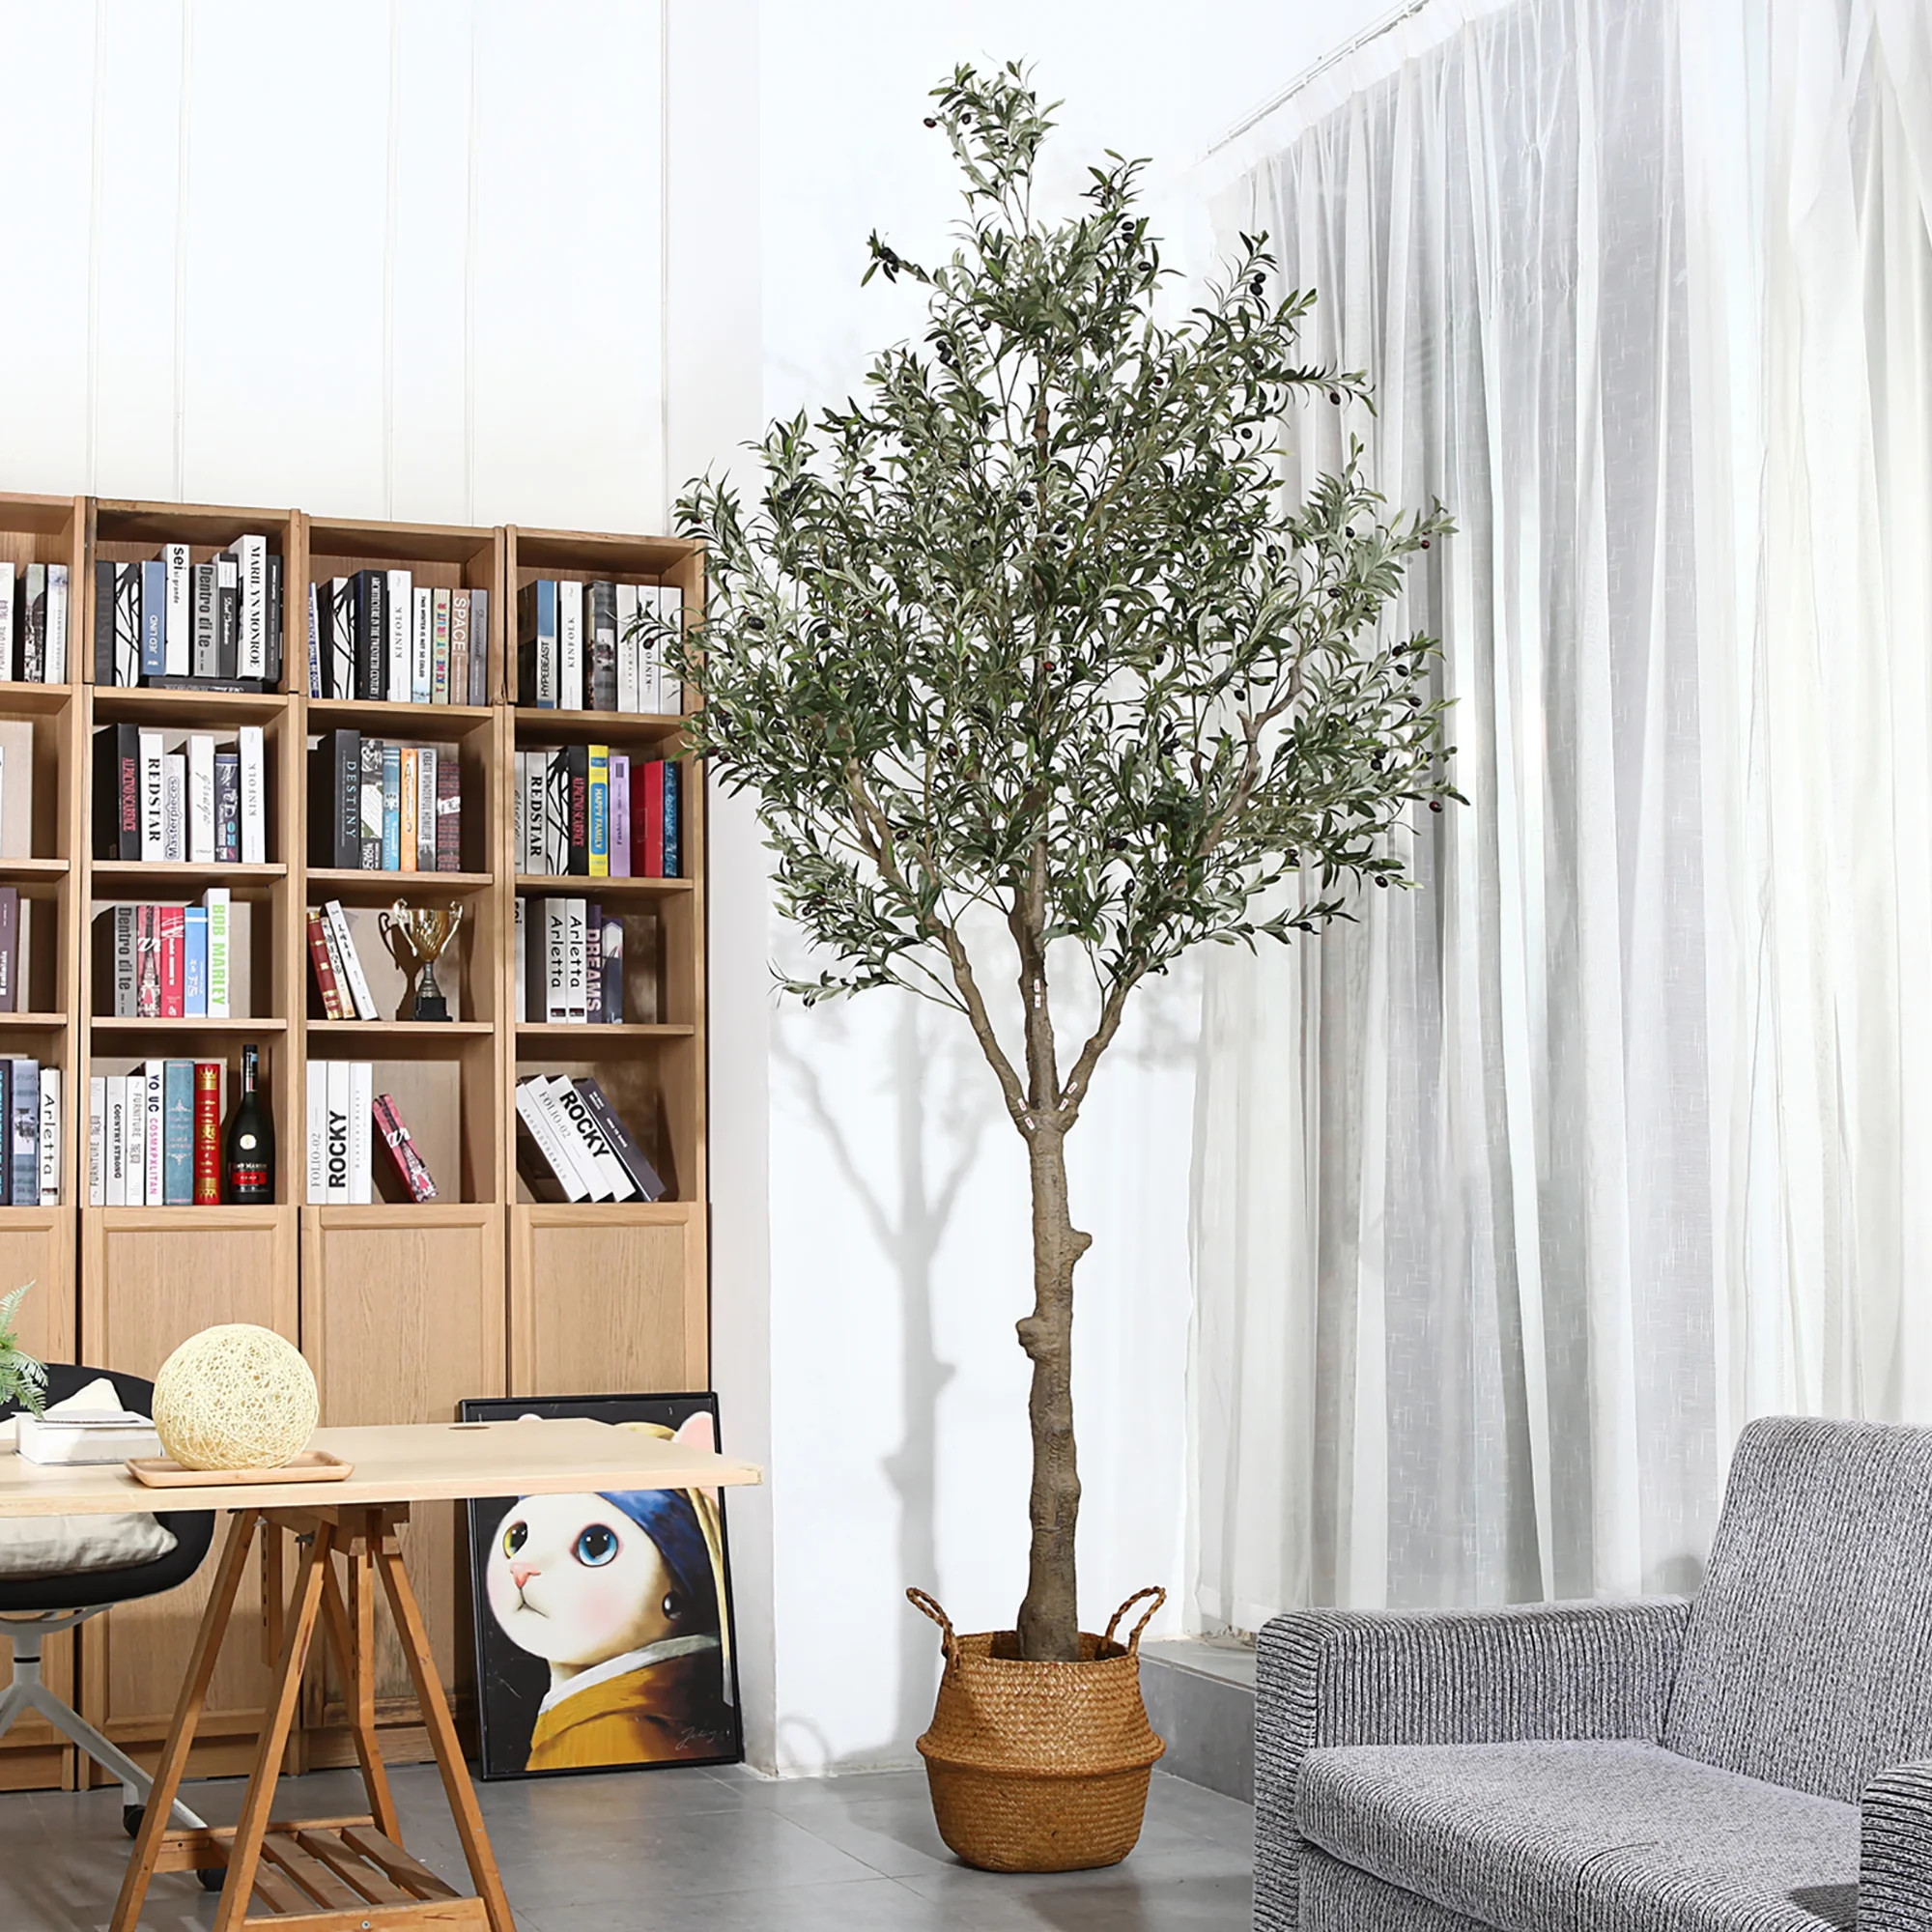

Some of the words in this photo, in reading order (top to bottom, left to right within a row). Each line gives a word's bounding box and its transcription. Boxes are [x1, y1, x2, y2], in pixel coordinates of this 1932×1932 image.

[174, 547, 186, 570] sei
[250, 546, 261, 608] MARILYN
[199, 566, 213, 612] Dentro
[199, 617, 213, 630] di
[199, 635, 213, 647] te
[250, 611, 261, 668] MONROE
[452, 597, 467, 651] SPACE
[541, 640, 550, 697] HYPEBEAST
[248, 763, 257, 816] KINFOLK
[423, 752, 433, 773] CREATE
[148, 758, 160, 841] REDSTAR
[167, 779, 181, 858] Masterpieces
[346, 761, 356, 838] DESTINY
[530, 777, 542, 856] REDSTAR
[118, 908, 132, 954] Dentro
[213, 904, 225, 936] BOB
[118, 960, 132, 972] di
[212, 943, 225, 1005] MARLEY
[551, 916, 563, 987] Arletta
[570, 916, 582, 987] Arletta
[587, 929, 601, 1011] DREAMS
[118, 978, 132, 990] te
[43, 1094, 55, 1175] Arletta
[132, 1093, 142, 1137] FURNITURE
[539, 1091, 571, 1139] FOLIO-02
[560, 1090, 610, 1158] ROCKY
[311, 1133, 321, 1186] FOLIO-02
[329, 1110, 346, 1188] ROCKY
